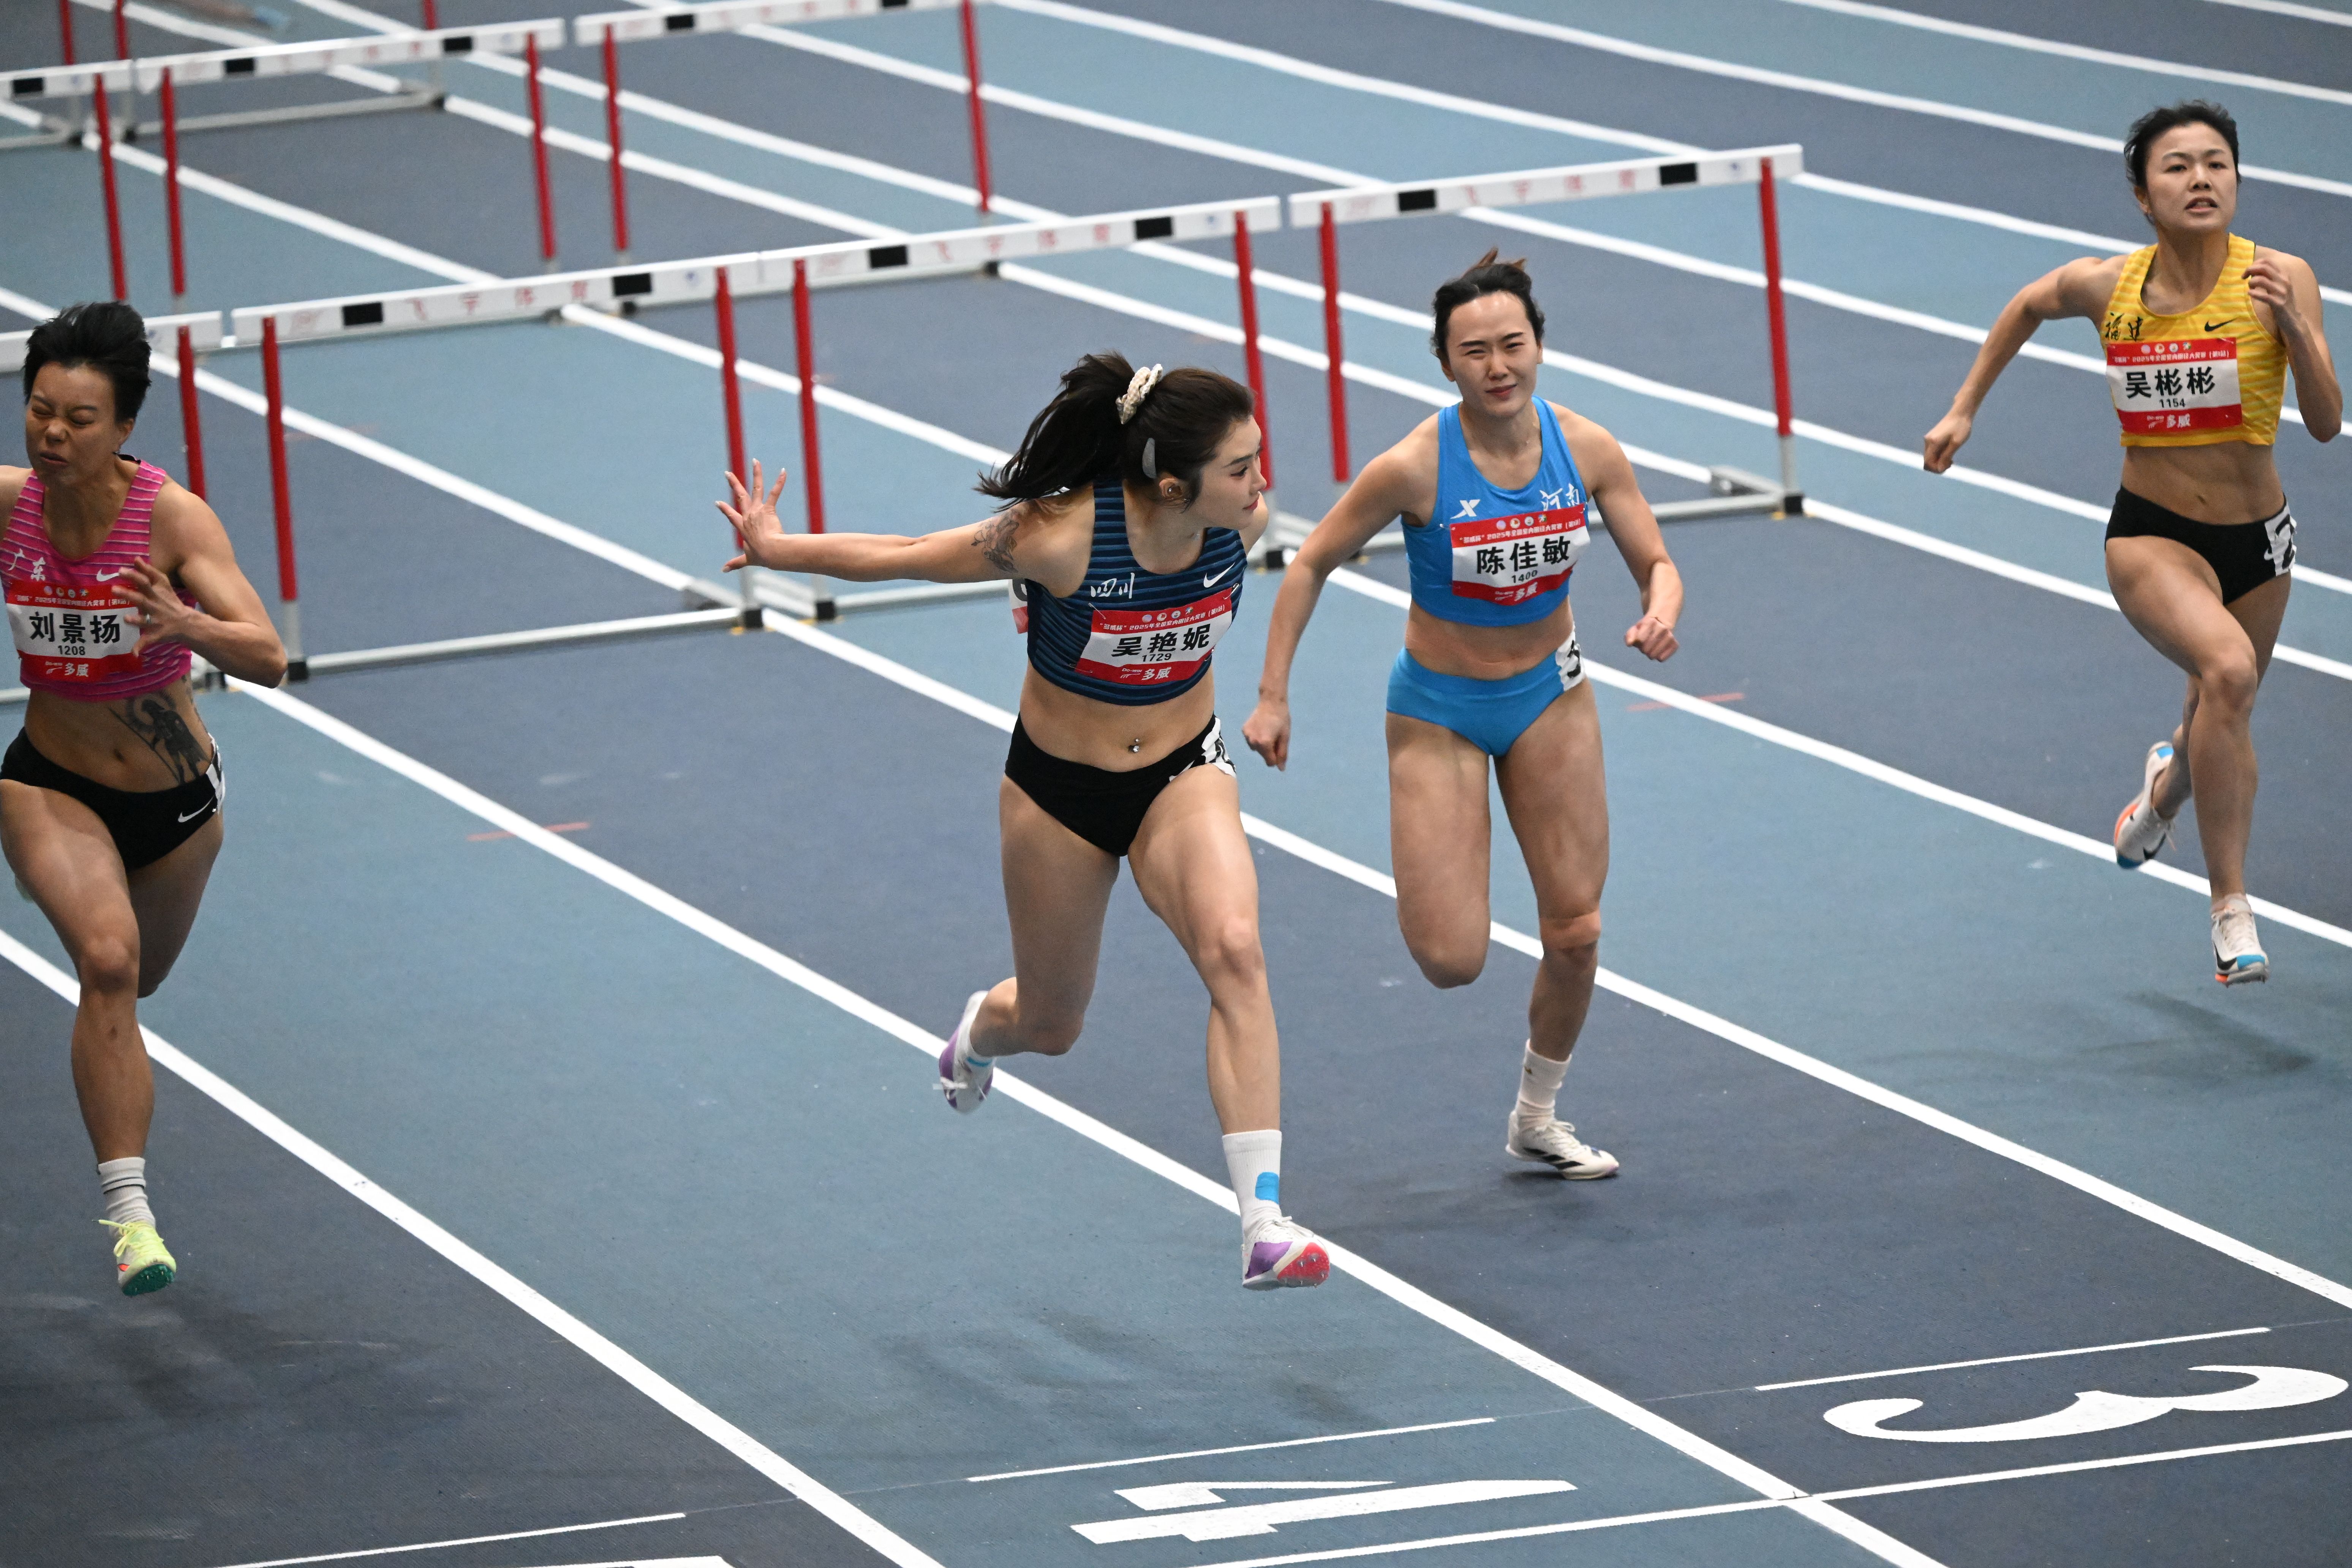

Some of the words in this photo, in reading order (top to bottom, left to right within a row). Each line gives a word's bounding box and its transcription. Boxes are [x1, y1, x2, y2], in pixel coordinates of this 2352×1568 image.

[2125, 366, 2215, 399] 吴彬彬
[2159, 398, 2186, 408] 1154
[1476, 536, 1571, 575] 陈佳敏
[1091, 572, 1135, 599] 四川
[1511, 569, 1538, 584] 1400
[29, 611, 120, 644] 刘景扬
[1111, 623, 1211, 657] 吴艳妮
[57, 645, 86, 655] 1208
[1141, 653, 1172, 662] 1729
[1141, 667, 1172, 680] 多威
[1823, 1365, 2349, 1442] 3
[1070, 1480, 1578, 1544] 4
